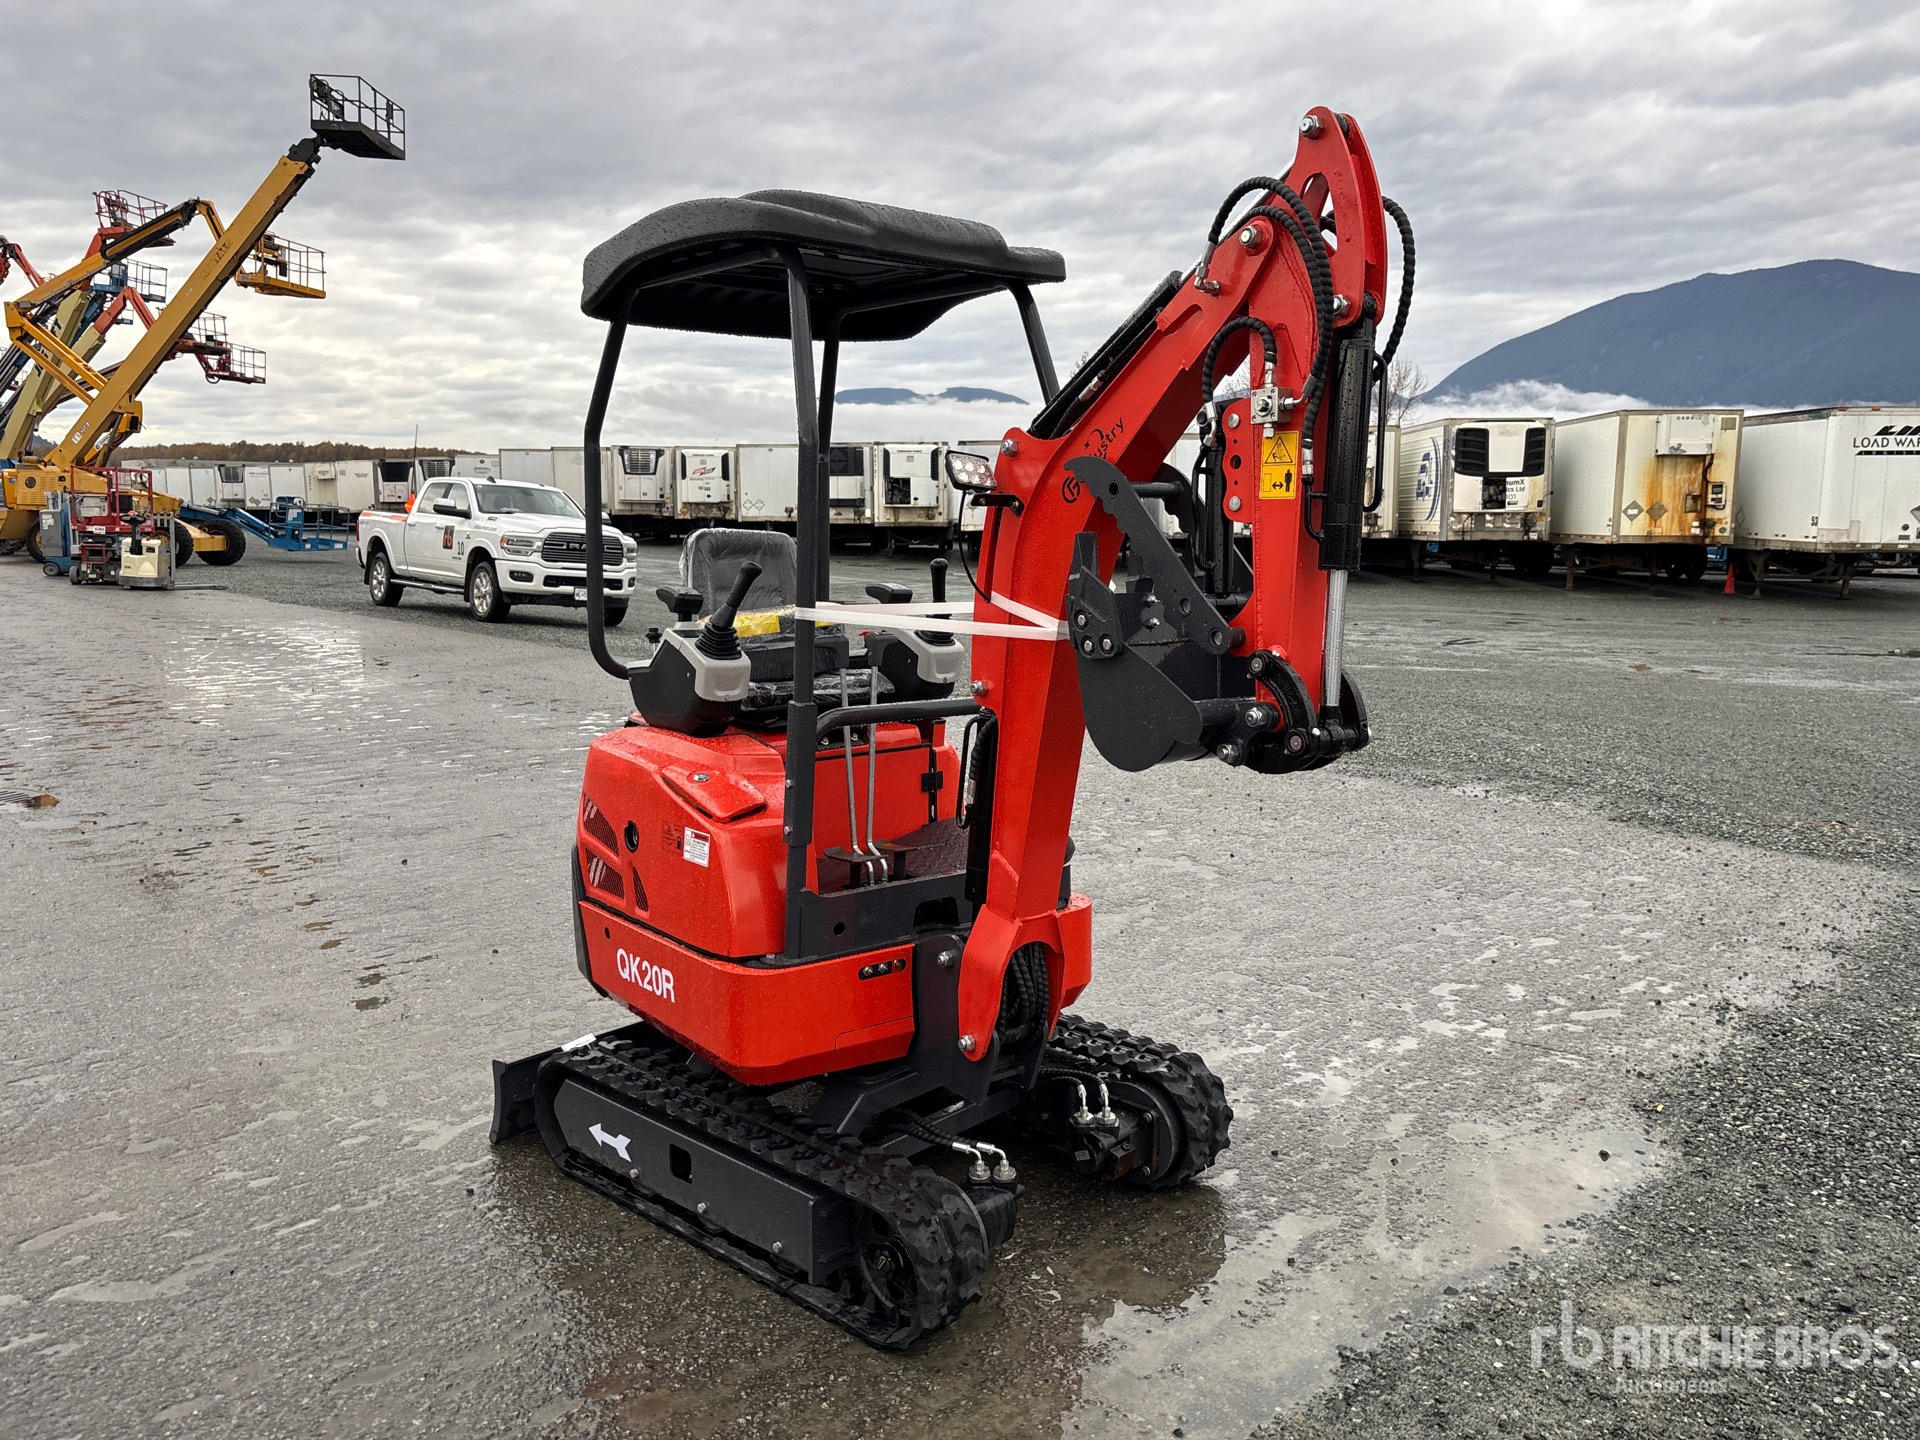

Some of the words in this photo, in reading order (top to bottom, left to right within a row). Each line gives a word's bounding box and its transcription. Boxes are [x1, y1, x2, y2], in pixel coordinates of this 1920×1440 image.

[1852, 436, 1890, 448] LOAD
[457, 541, 465, 556] 10
[616, 947, 676, 1004] QK20R
